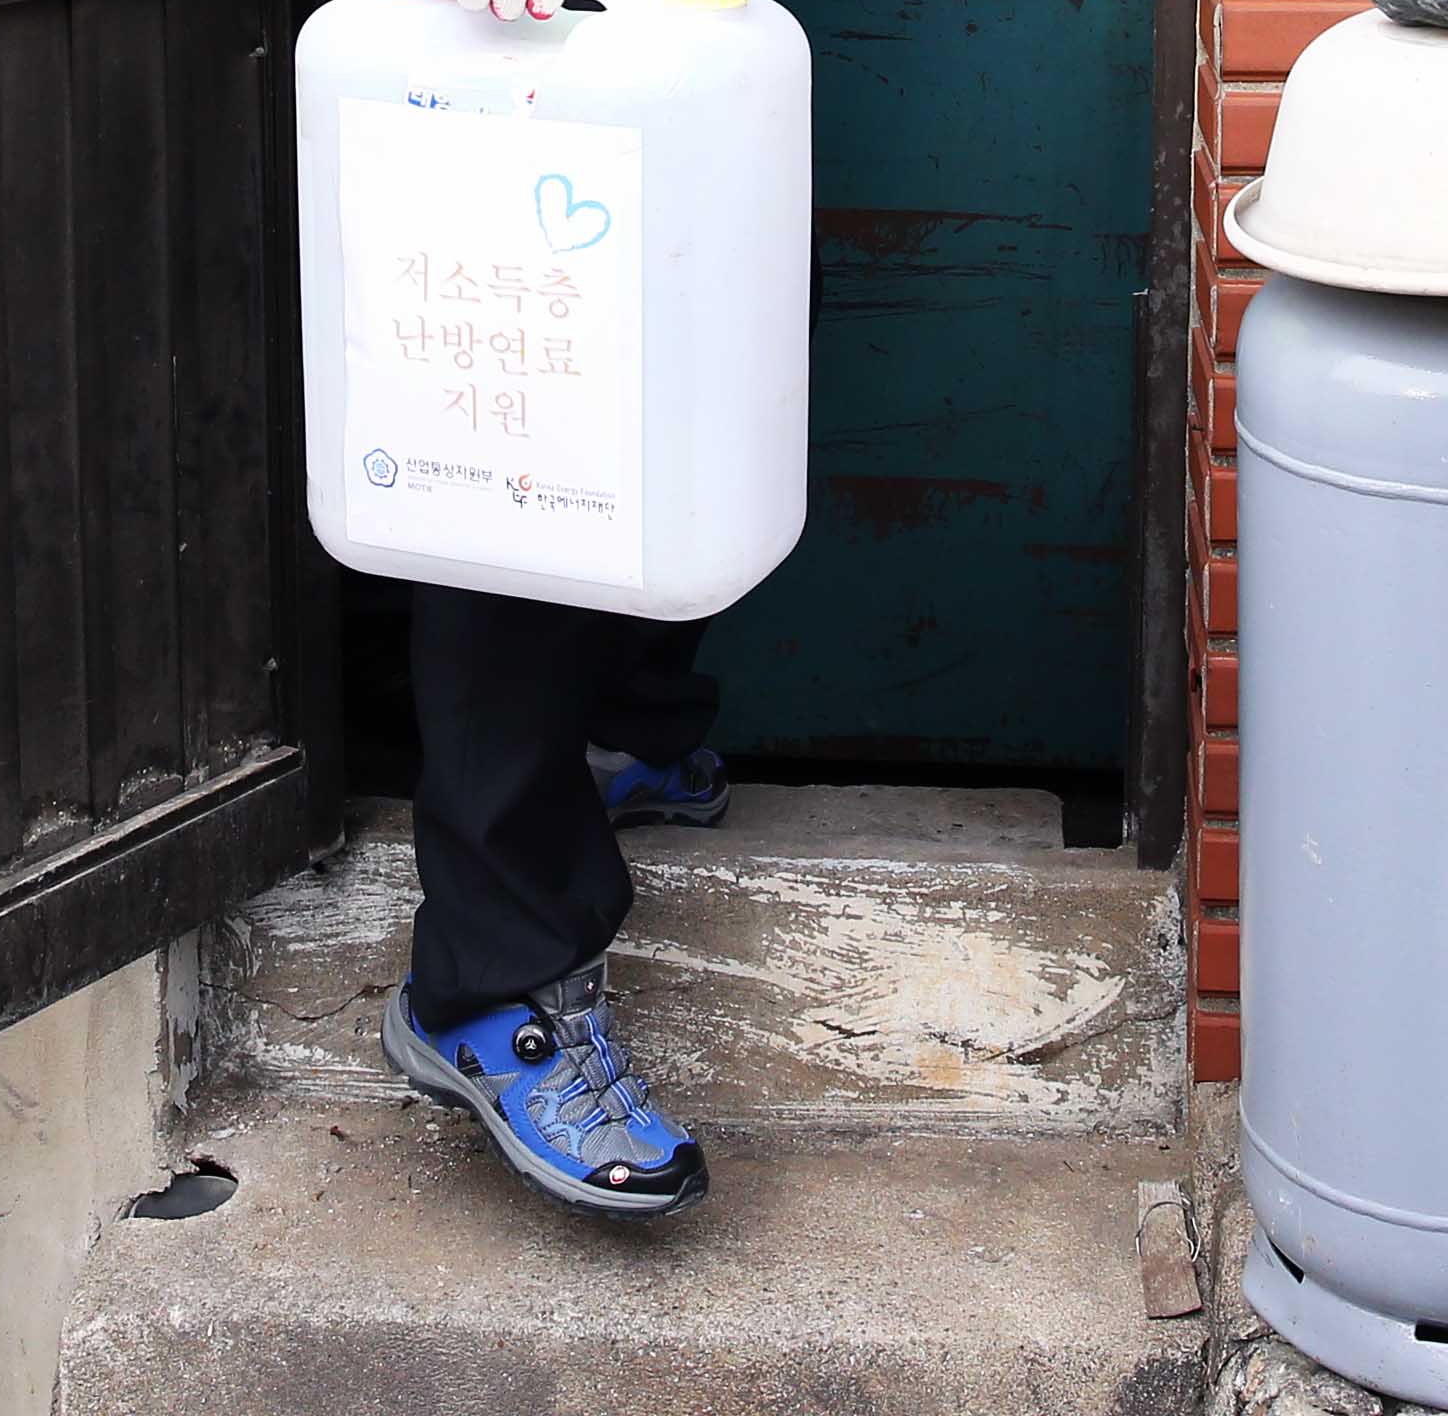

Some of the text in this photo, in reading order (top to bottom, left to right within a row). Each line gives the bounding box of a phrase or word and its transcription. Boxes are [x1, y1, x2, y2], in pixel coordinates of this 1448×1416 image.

[393, 253, 584, 318] 저소득층
[391, 315, 583, 377] 난방연료
[444, 384, 531, 439] 지원
[405, 457, 493, 483] 산업통상지원부
[536, 493, 615, 521] 한국에너지재단
